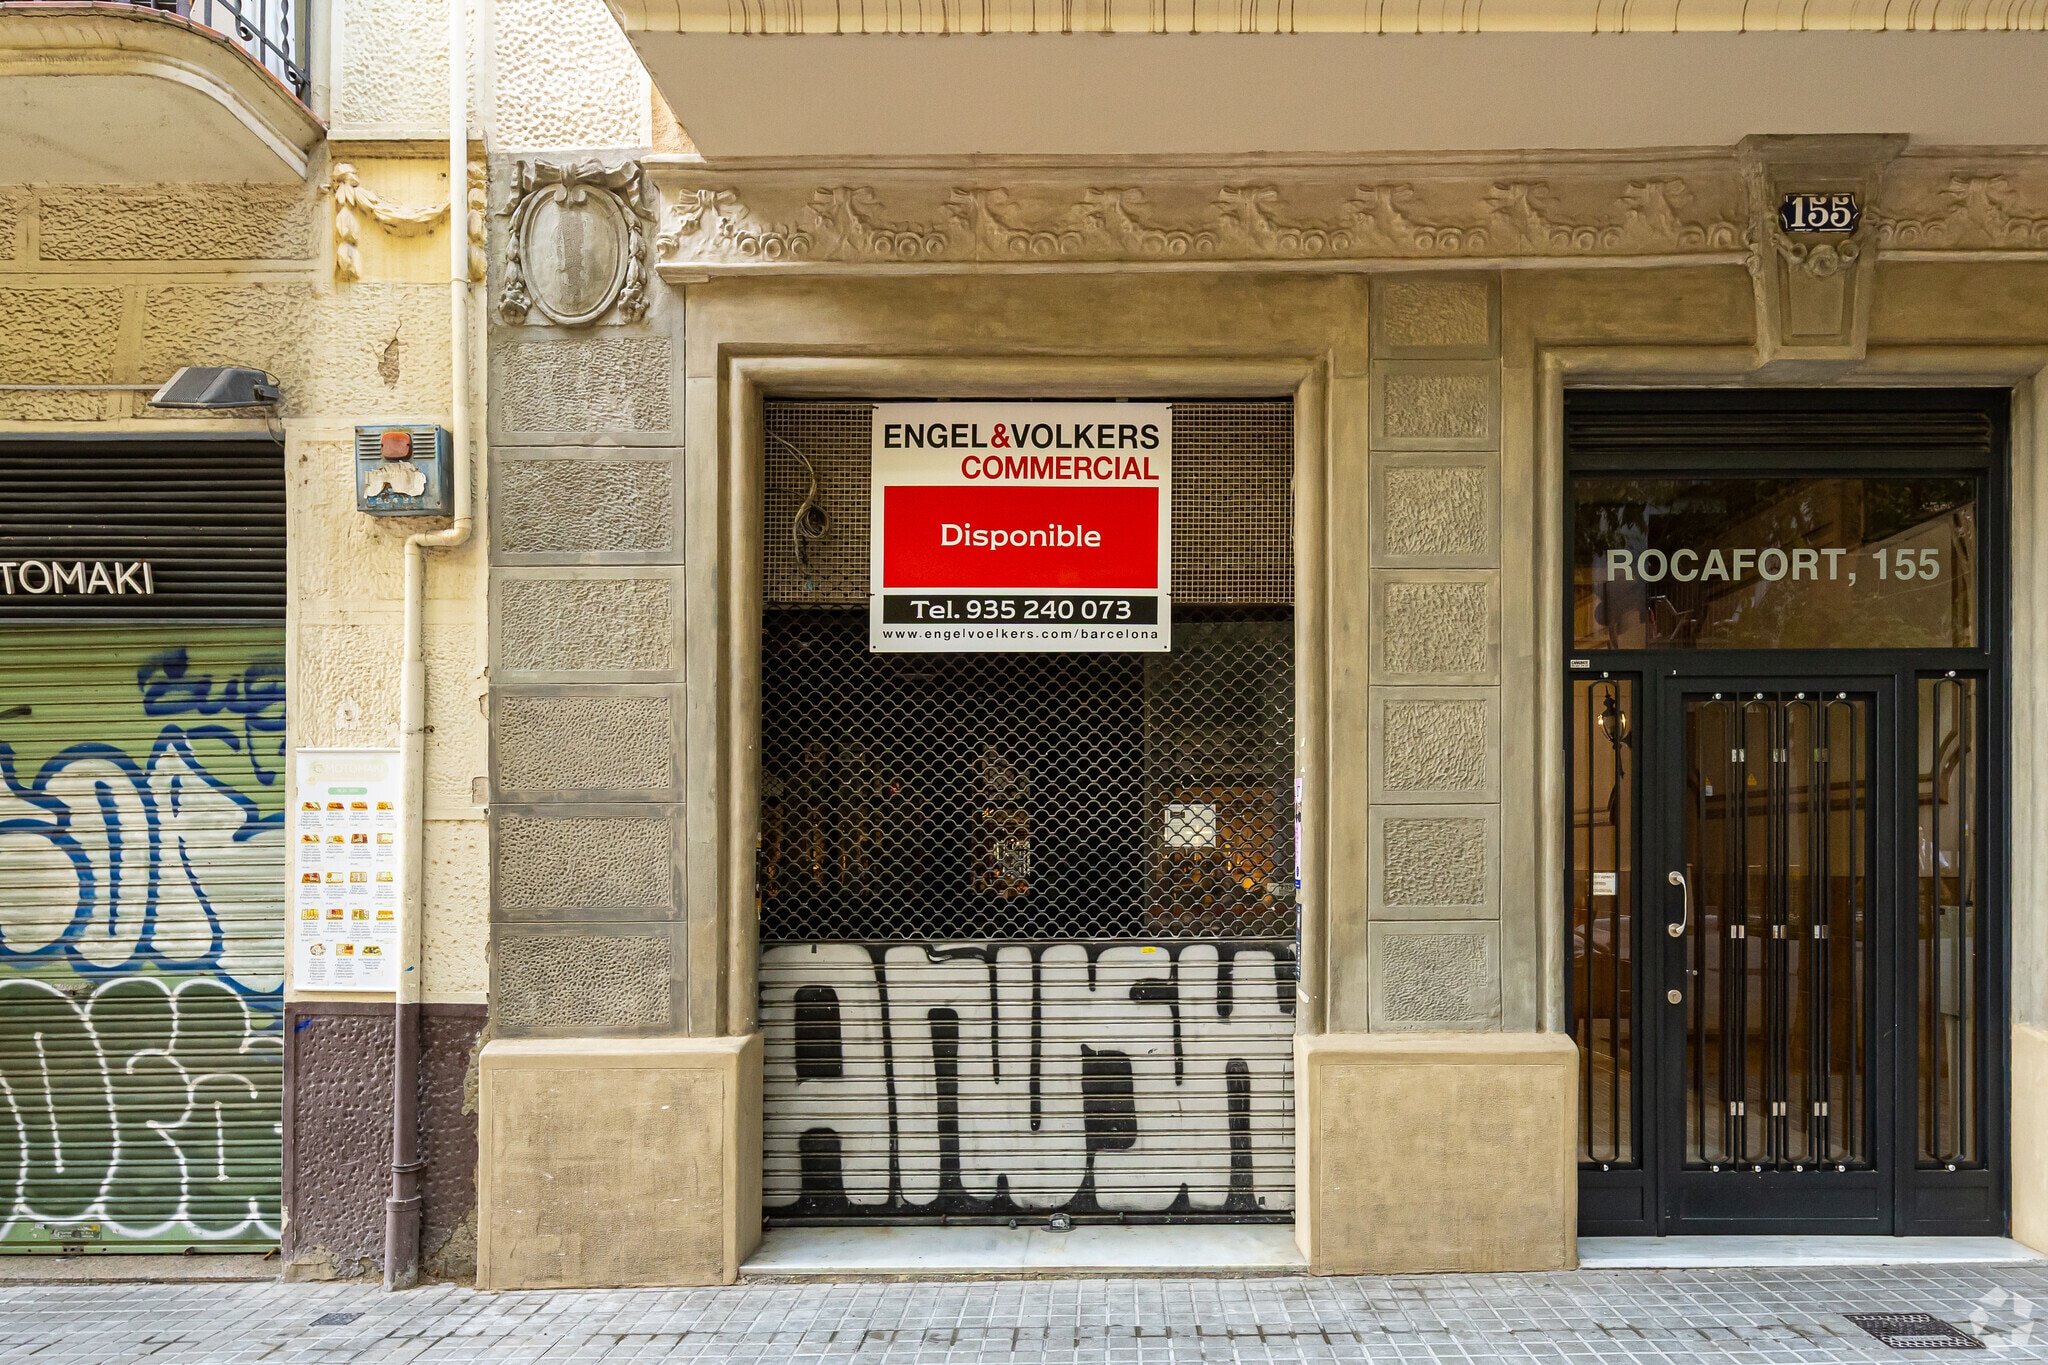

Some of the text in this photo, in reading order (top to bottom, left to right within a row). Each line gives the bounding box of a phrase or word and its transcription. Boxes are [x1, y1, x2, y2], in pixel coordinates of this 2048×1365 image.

[1790, 196, 1851, 228] 155
[884, 423, 1160, 449] ENGEL&VOLKERS
[961, 455, 1160, 480] COMMERCIAL
[940, 522, 1102, 551] Disponible
[0, 560, 153, 595] TOMAKI
[1606, 547, 1941, 587] ROCAFORT, 155
[910, 600, 1132, 620] Tel. 935 240 073
[882, 628, 1159, 641] www.engelvoelkers.com/barcelona
